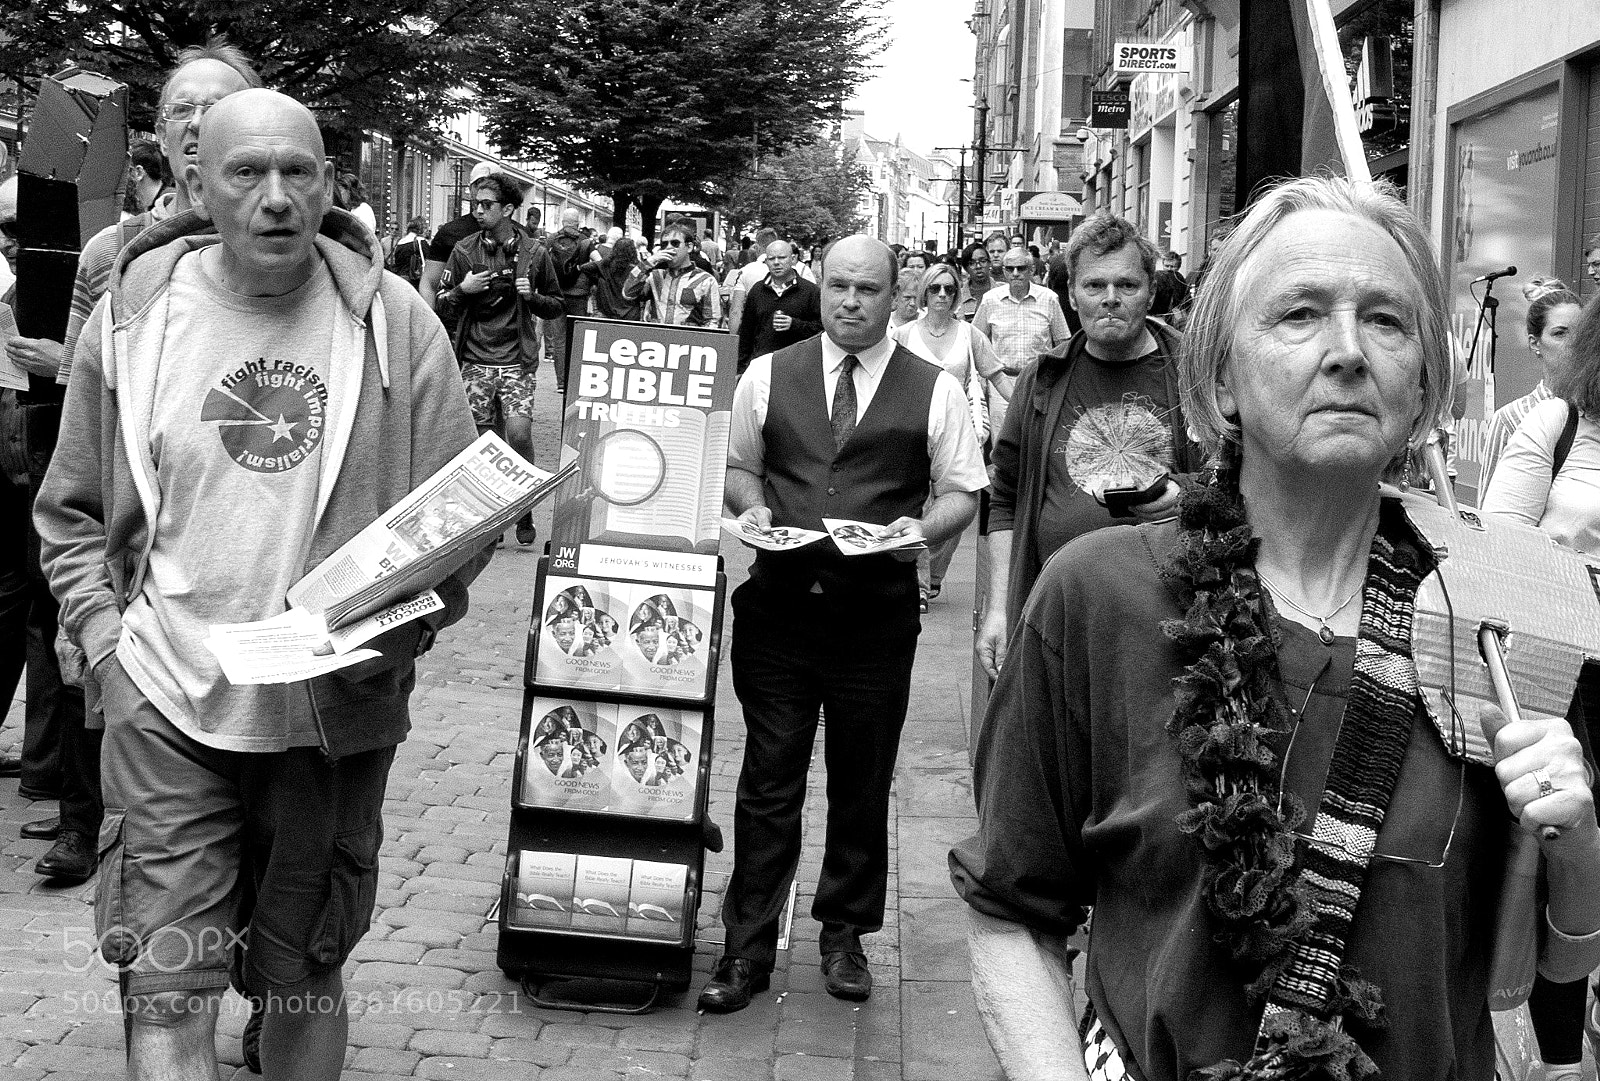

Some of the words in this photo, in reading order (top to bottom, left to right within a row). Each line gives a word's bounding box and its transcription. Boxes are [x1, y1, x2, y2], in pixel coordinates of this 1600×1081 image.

[1120, 47, 1176, 60] SPORTS
[1098, 105, 1125, 113] Metro
[582, 330, 717, 373] Learn
[220, 357, 267, 390] fight
[255, 372, 306, 391] fight
[578, 364, 715, 408] BIBLE
[575, 400, 681, 428] TRUTHS
[466, 455, 508, 489] FIGHT
[479, 442, 536, 486] FIGHT
[556, 547, 576, 559] JW
[599, 557, 649, 568] JEHOVAH'S
[652, 561, 703, 572] WITNESSES
[379, 600, 438, 628] BOYCOTT
[650, 666, 673, 674] GOOD
[638, 788, 661, 796] GOOD
